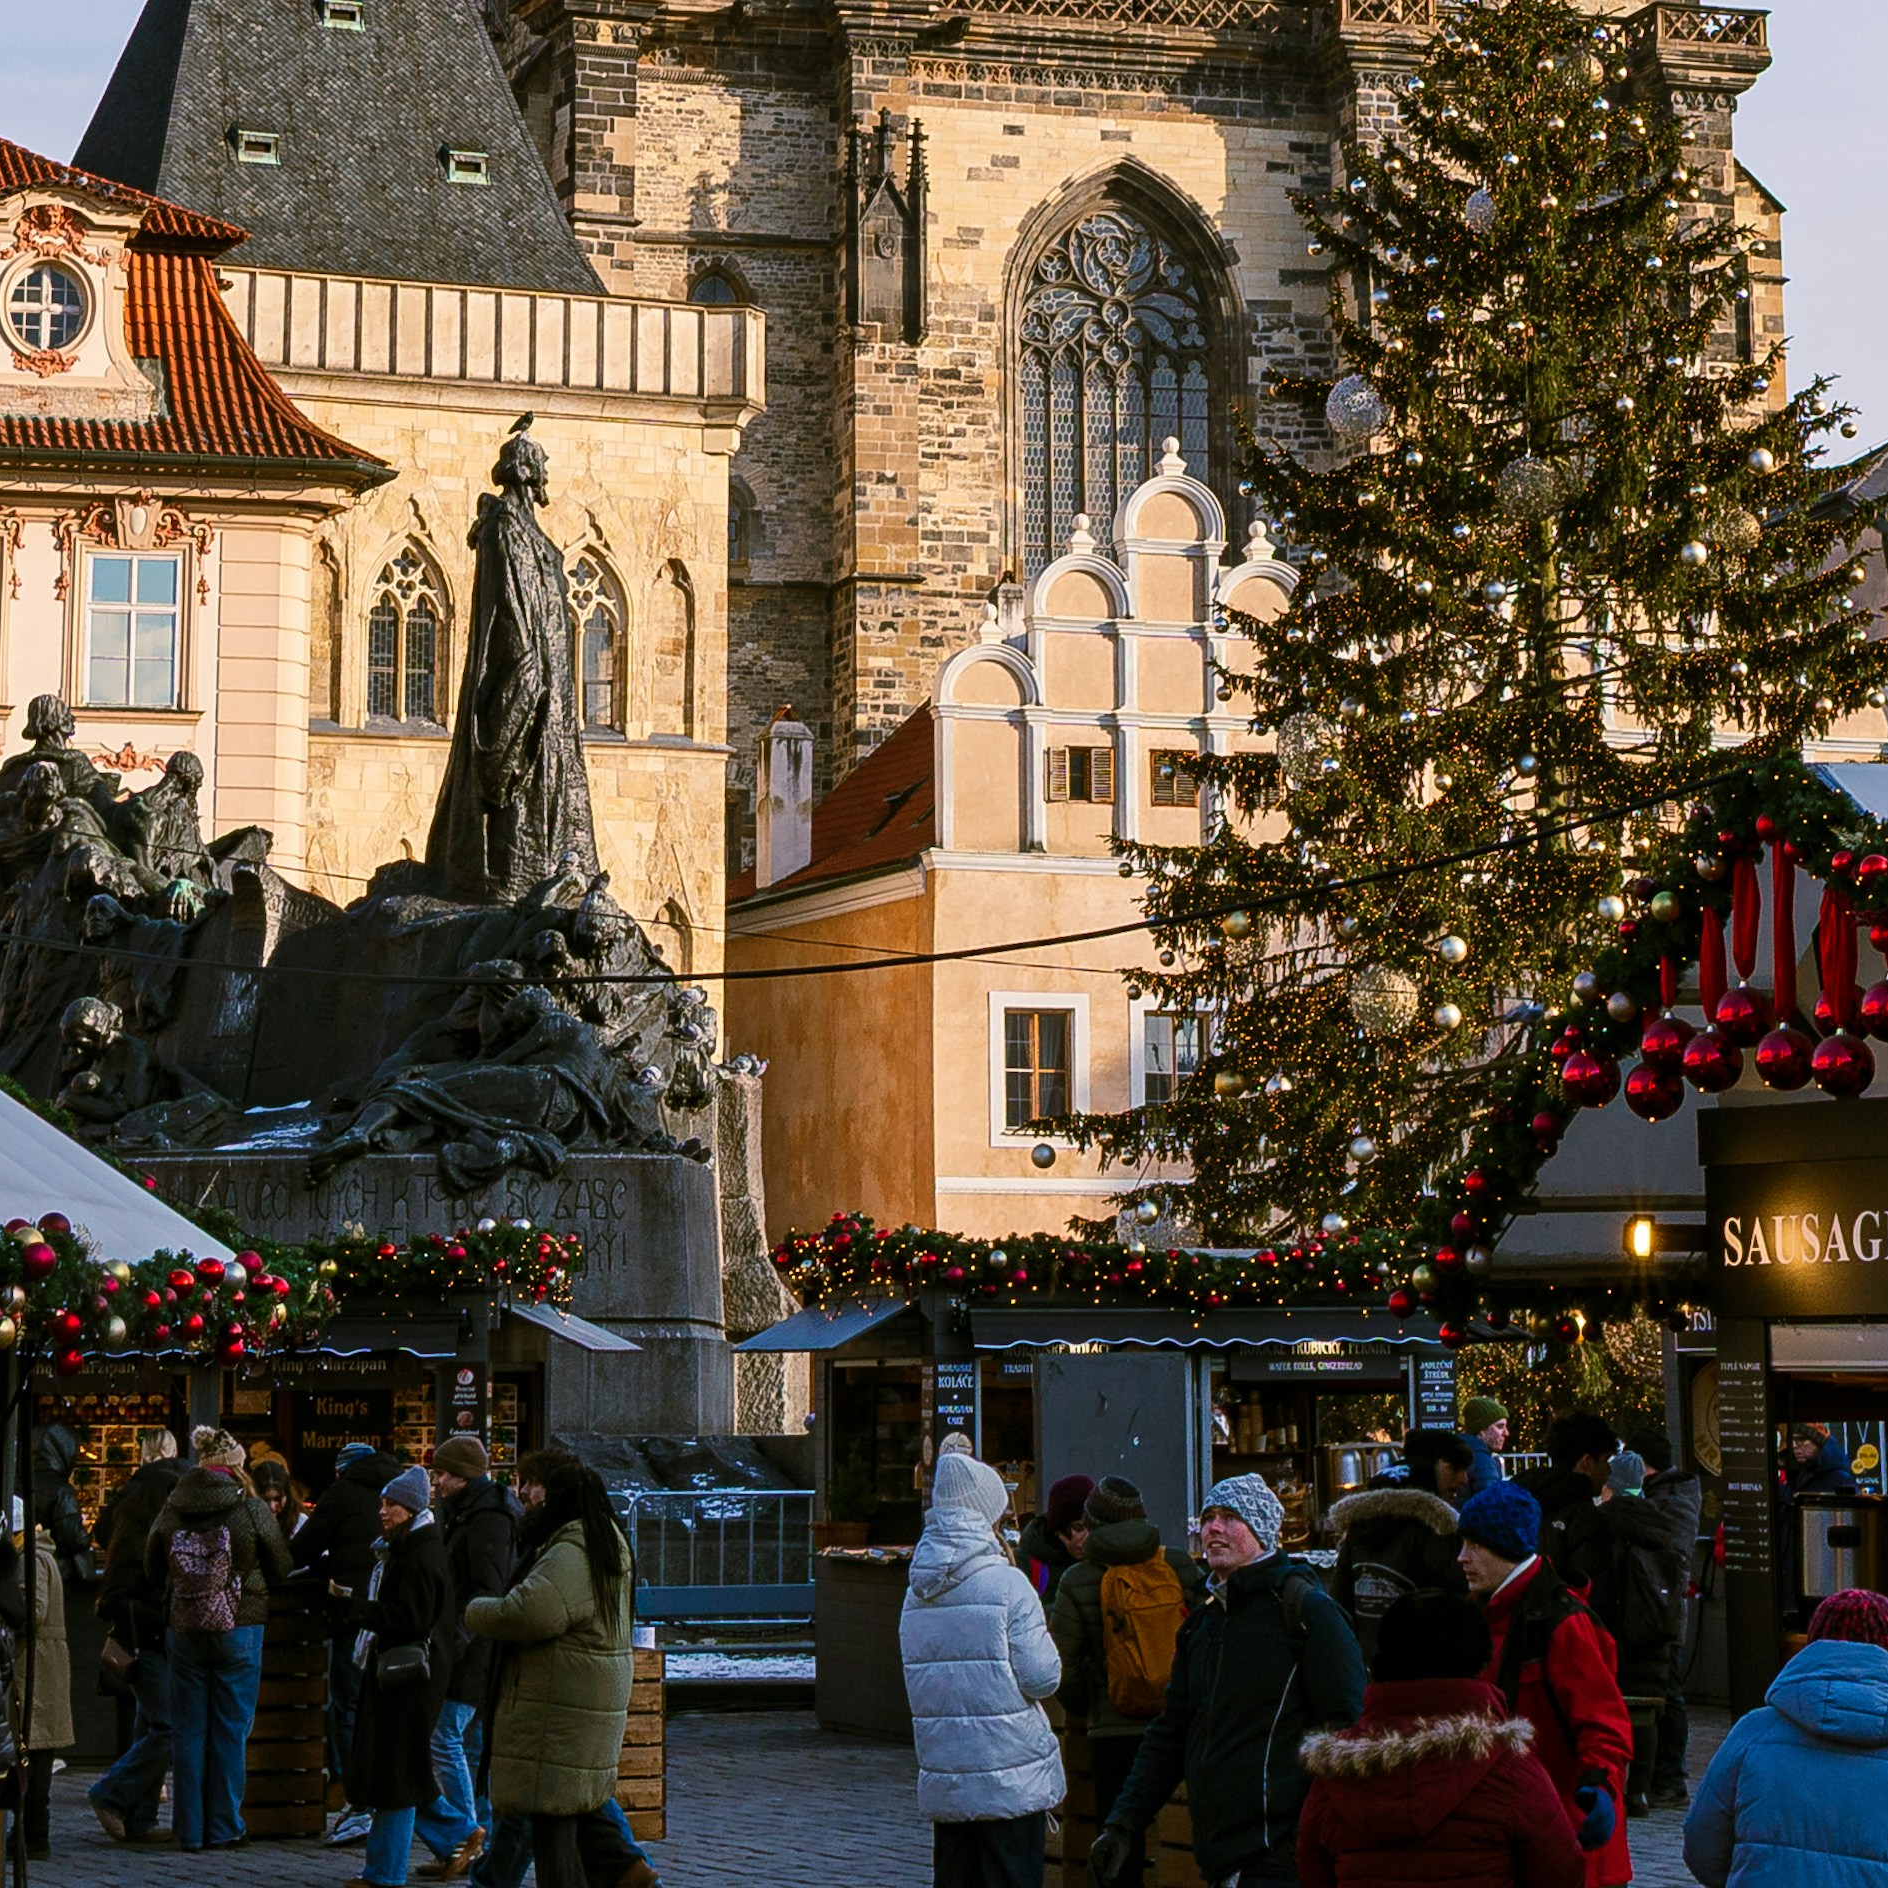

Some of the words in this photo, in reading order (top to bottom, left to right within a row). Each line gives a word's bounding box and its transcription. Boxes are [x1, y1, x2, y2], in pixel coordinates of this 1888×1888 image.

[319, 1356, 387, 1374] Marzipan
[937, 1373, 974, 1389] KOLÁČE
[316, 1397, 369, 1419] King's
